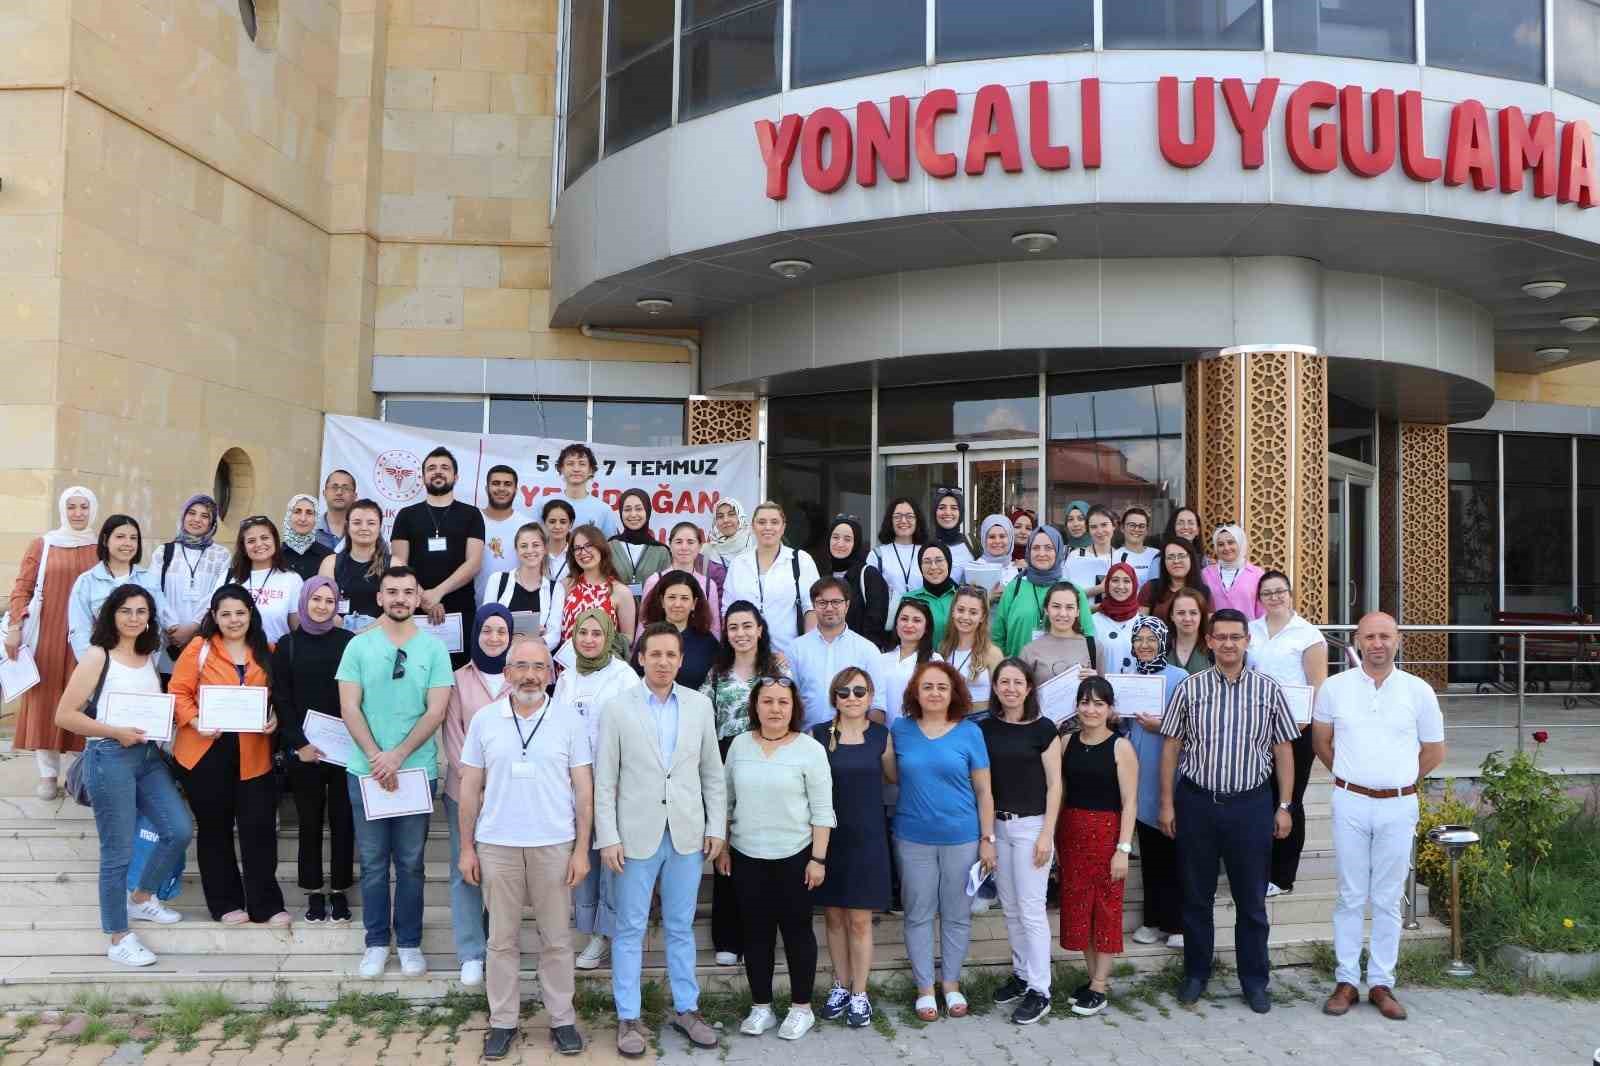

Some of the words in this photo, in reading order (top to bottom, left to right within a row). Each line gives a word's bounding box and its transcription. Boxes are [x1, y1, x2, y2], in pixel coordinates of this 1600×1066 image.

[755, 78, 1102, 199] YONCALI
[1157, 76, 1600, 208] UYGULAMA
[536, 455, 549, 472] 5
[603, 460, 617, 476] 7
[627, 458, 720, 476] TEMMUZ
